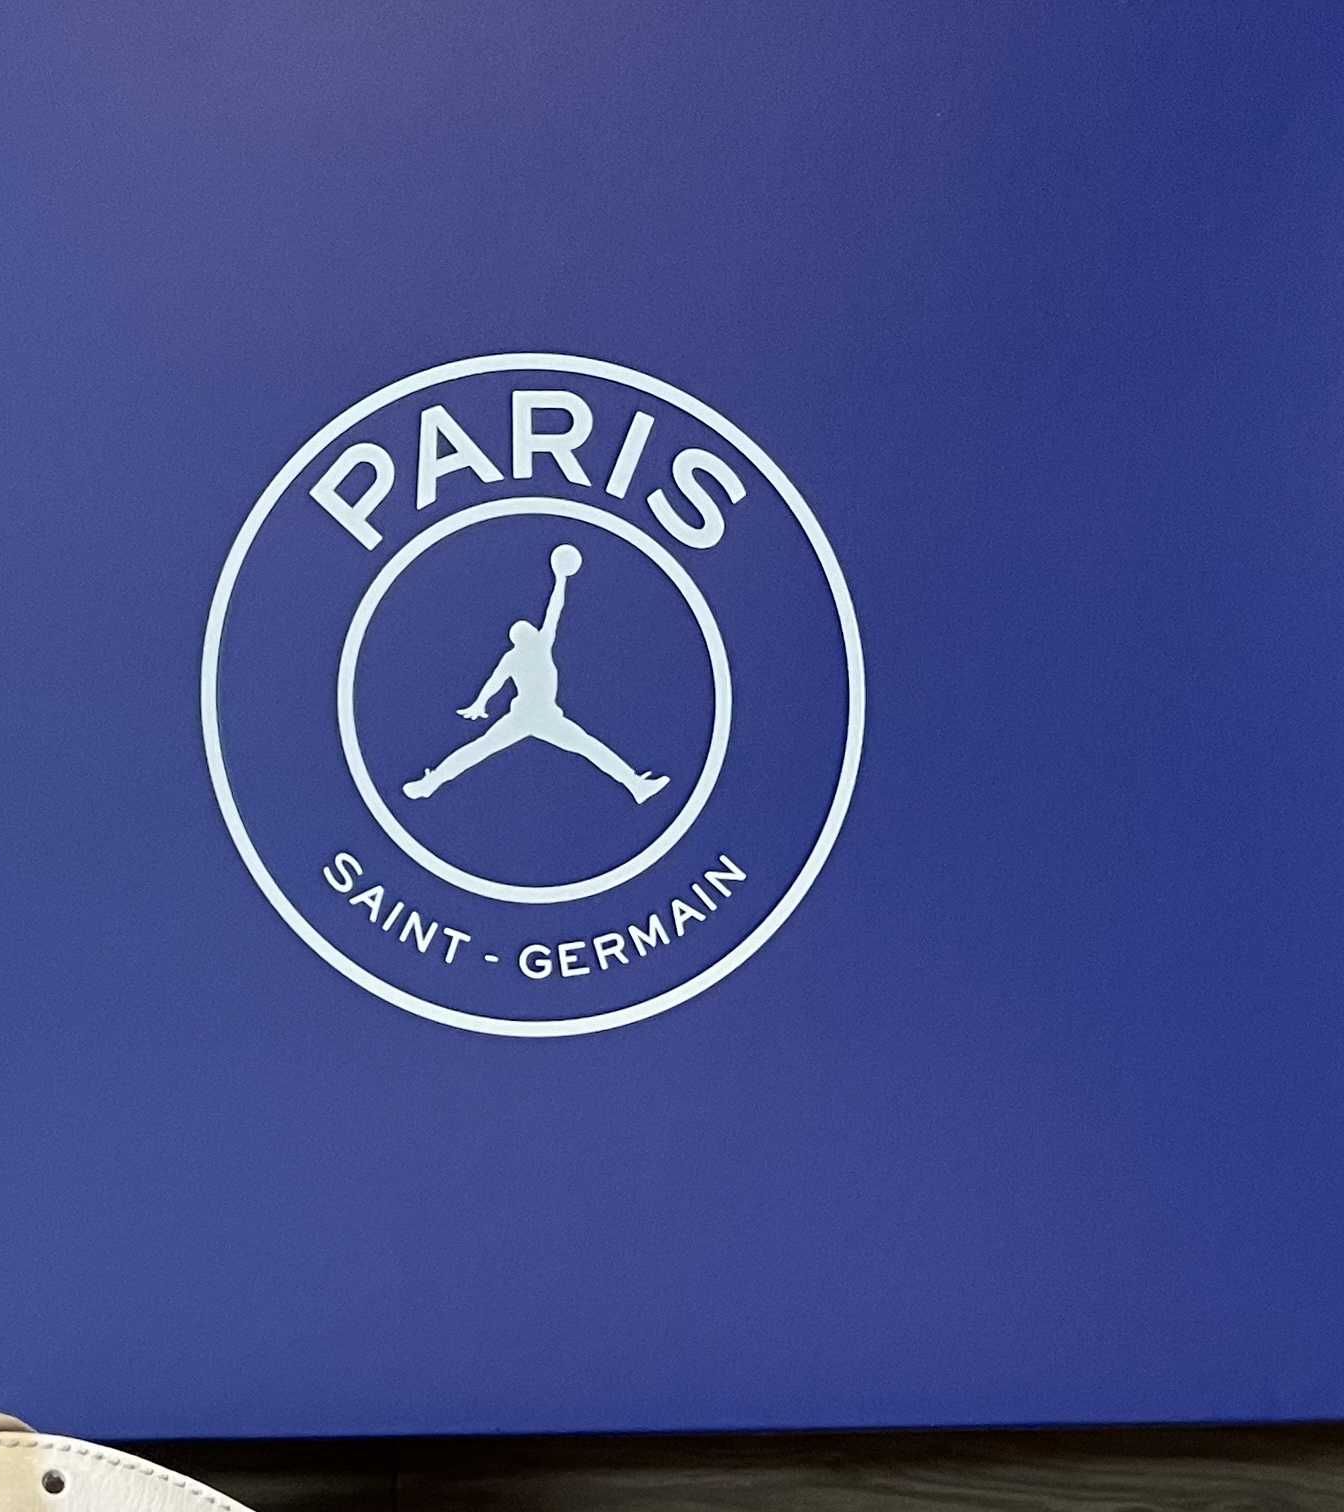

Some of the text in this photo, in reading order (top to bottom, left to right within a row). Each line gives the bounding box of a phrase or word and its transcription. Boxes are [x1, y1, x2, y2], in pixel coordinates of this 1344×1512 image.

[309, 389, 747, 551] PARIS
[323, 852, 472, 965] SAINT
[519, 854, 747, 979] GERMAIN
